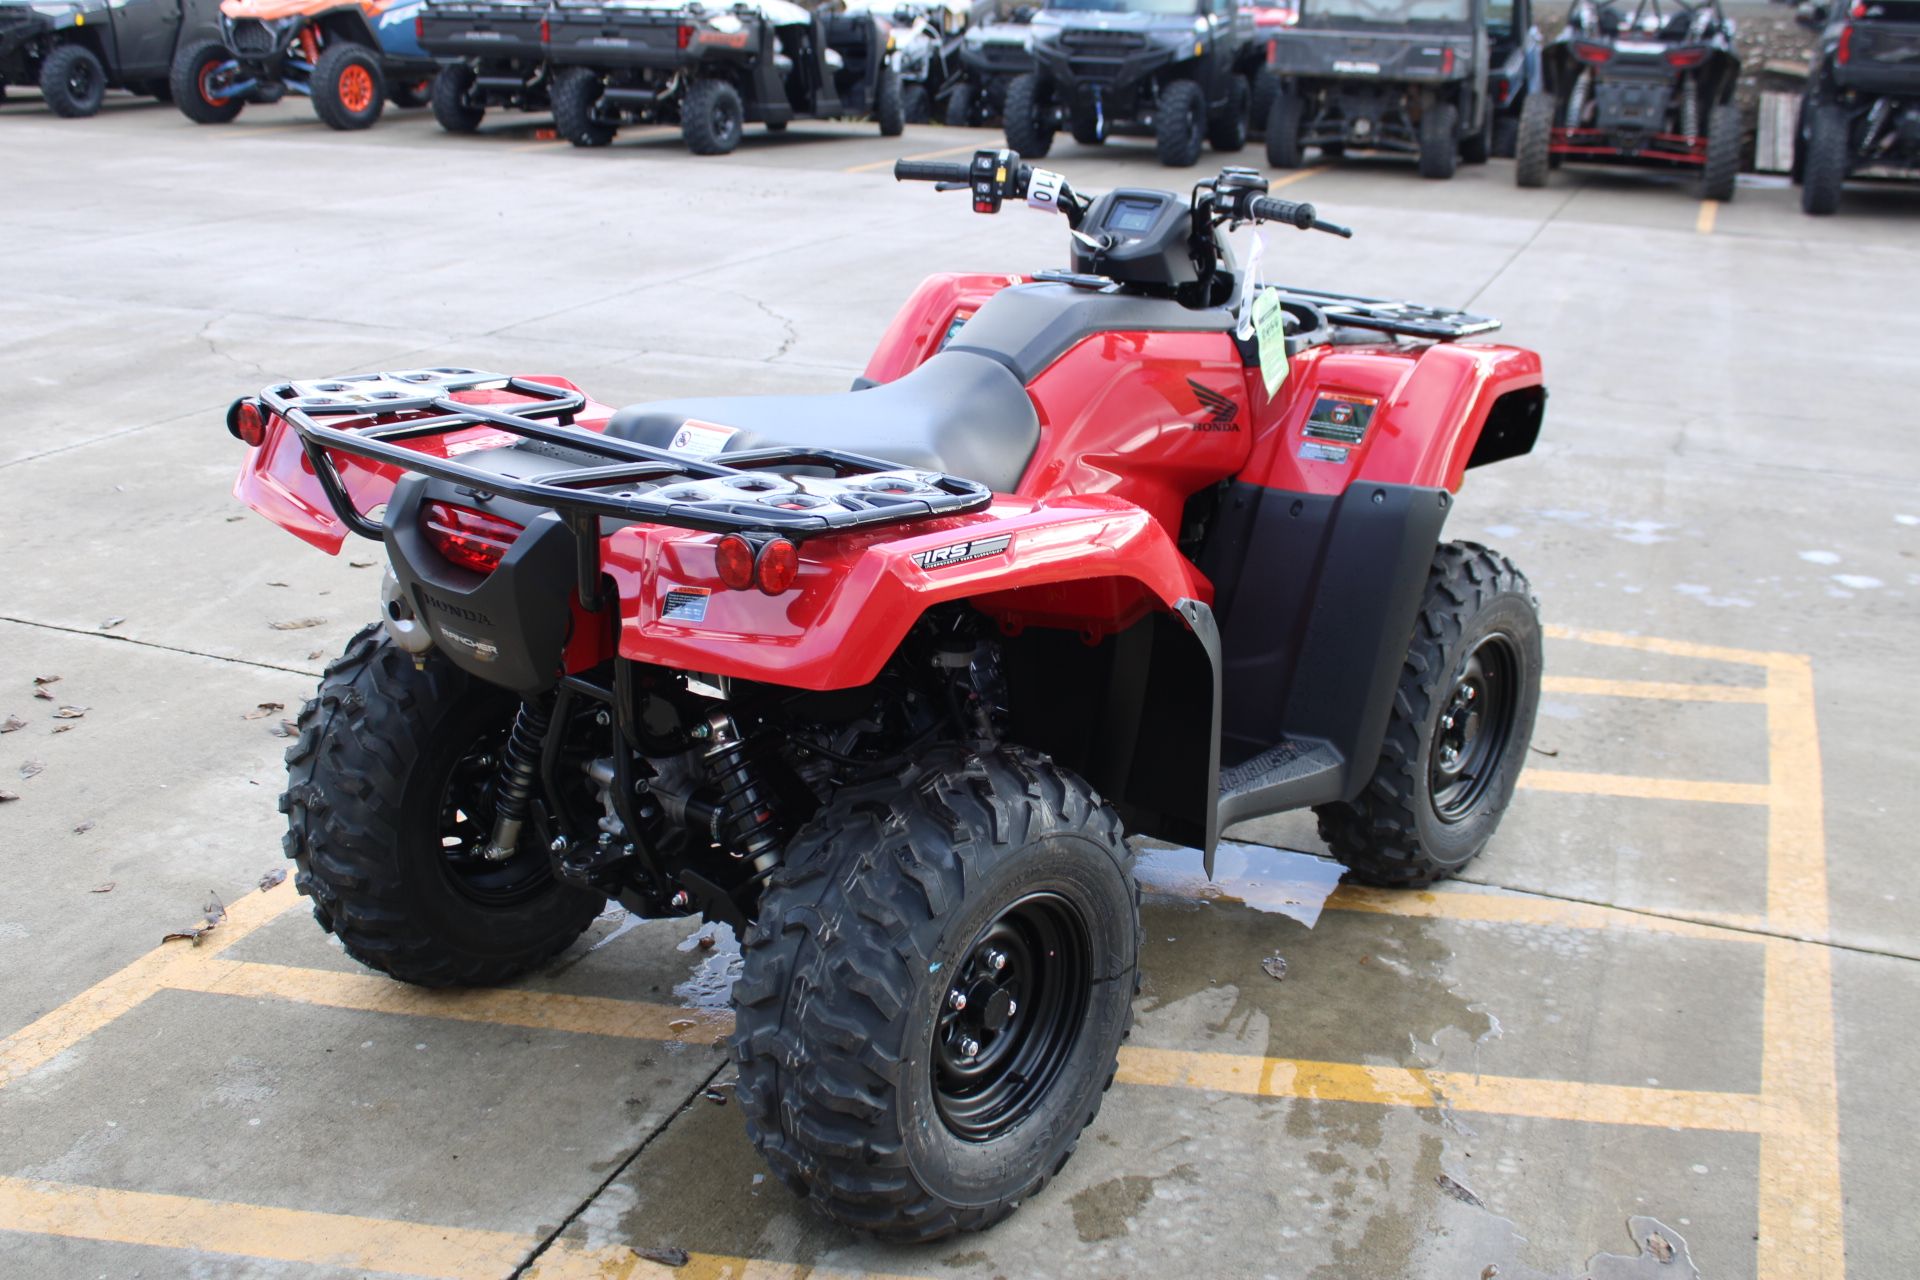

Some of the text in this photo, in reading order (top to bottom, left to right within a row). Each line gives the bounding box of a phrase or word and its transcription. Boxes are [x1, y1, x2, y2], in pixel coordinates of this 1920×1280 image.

[1192, 422, 1242, 432] HONDA
[924, 543, 969, 564] IRS
[423, 593, 497, 627] HONDA
[440, 627, 499, 655] RANCHER
